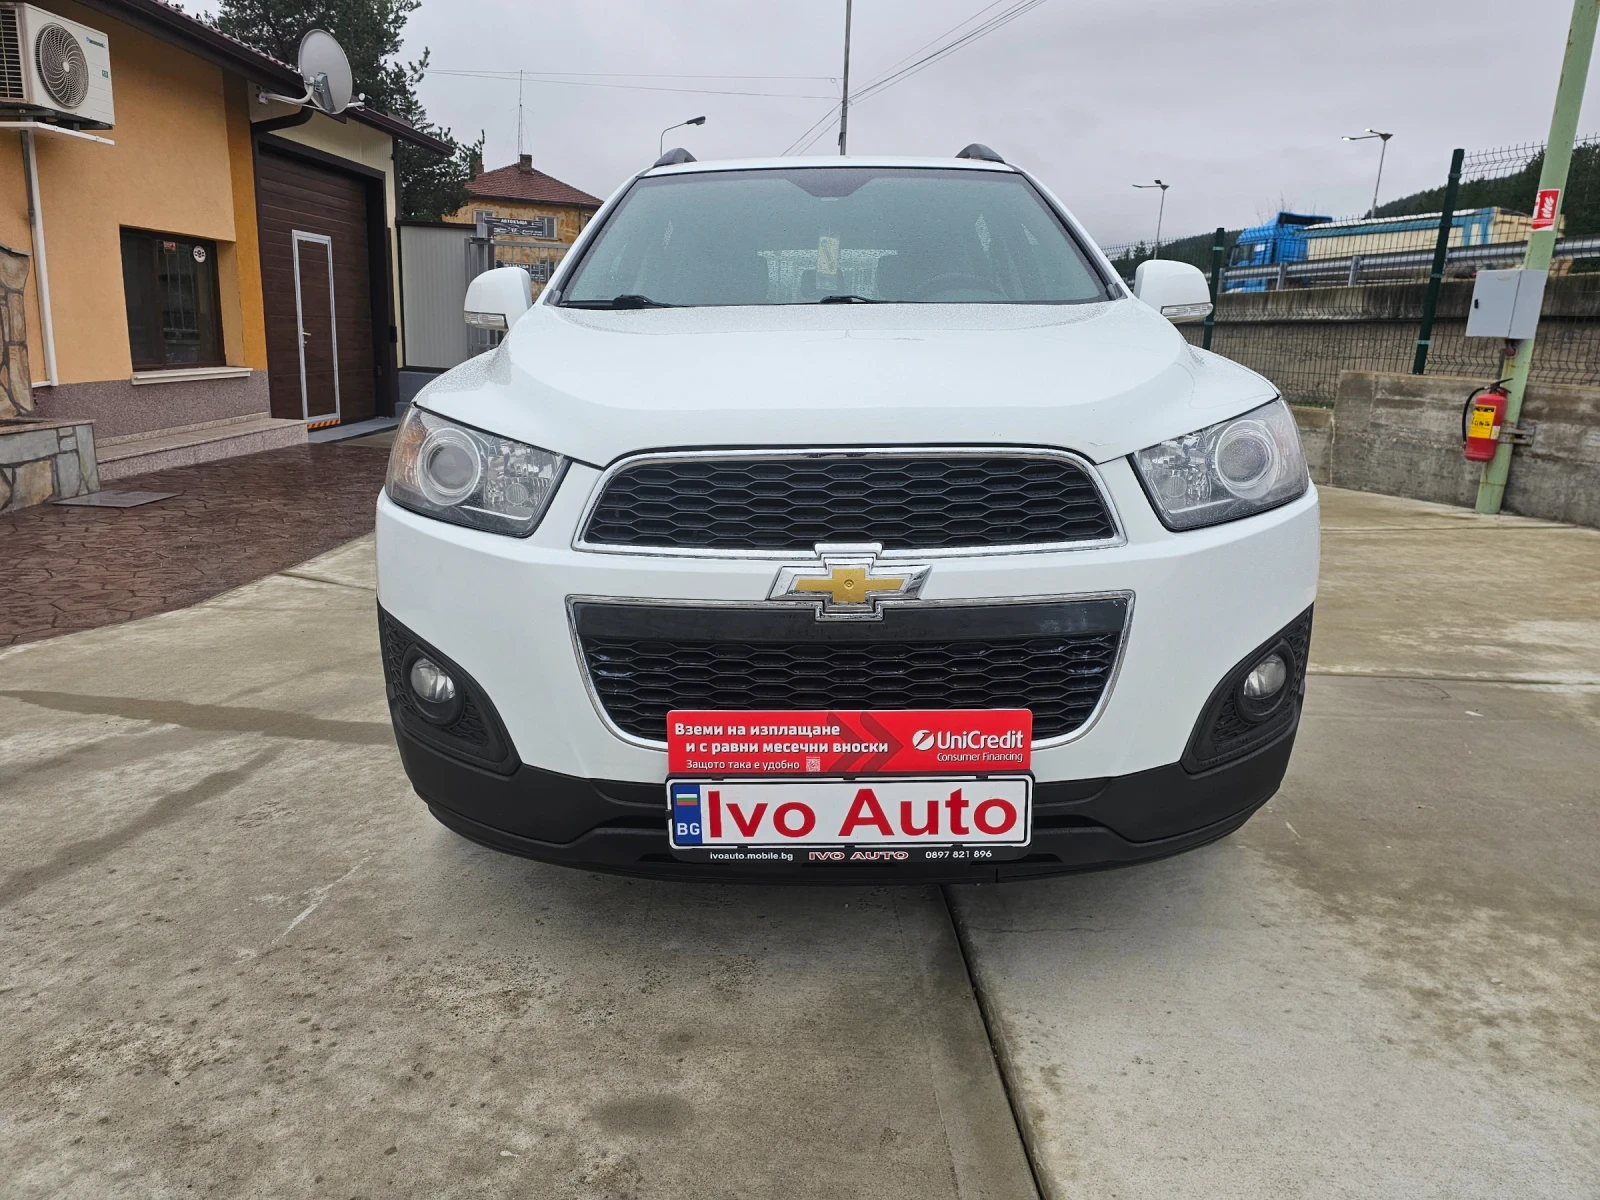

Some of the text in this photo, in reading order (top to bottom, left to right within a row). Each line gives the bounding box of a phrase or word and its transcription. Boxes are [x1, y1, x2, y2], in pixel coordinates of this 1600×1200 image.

[674, 722, 841, 738] Вземи на изплащане
[937, 730, 1024, 749] UniCredit
[685, 742, 888, 755] и с равни месечни вноски
[937, 752, 1023, 763] Consumer Financing
[686, 759, 800, 771] Защото така е удобно
[707, 788, 1018, 838] Ivo Auto
[677, 823, 700, 836] BG
[709, 851, 794, 861] ivoauto.mobile.bg
[808, 851, 910, 861] IVO AUTO
[925, 850, 993, 860] 0897 821 896
